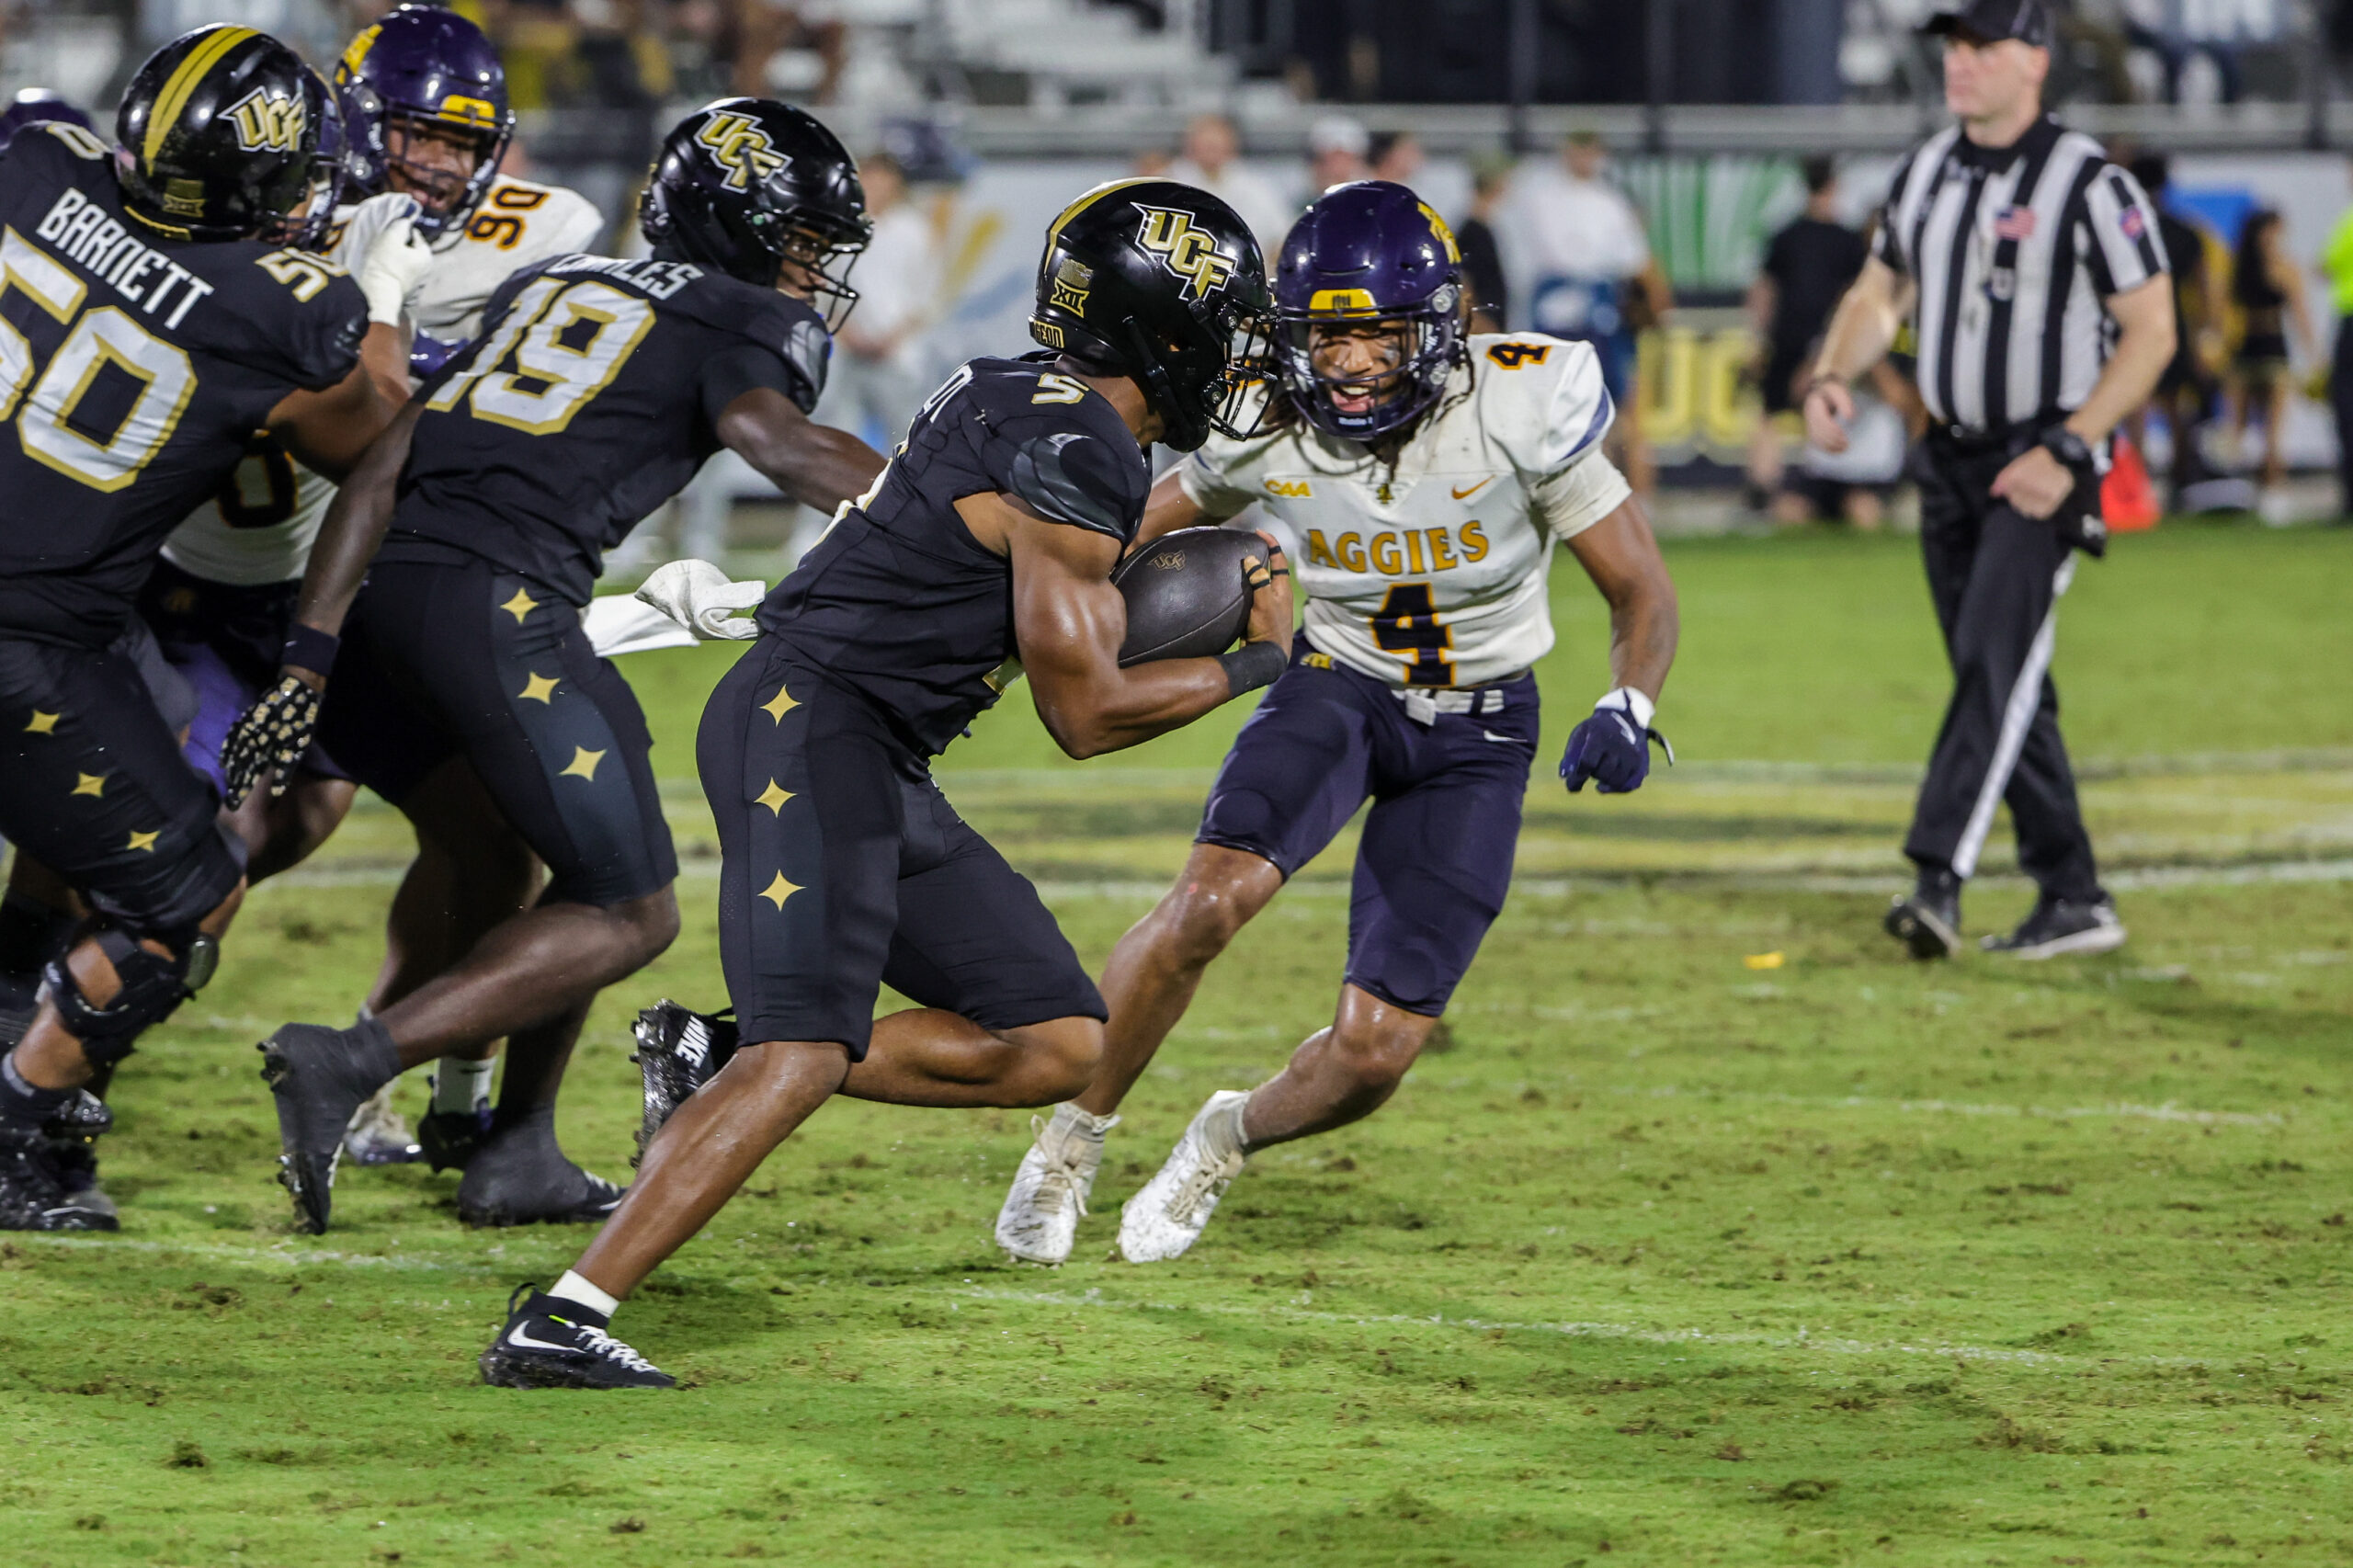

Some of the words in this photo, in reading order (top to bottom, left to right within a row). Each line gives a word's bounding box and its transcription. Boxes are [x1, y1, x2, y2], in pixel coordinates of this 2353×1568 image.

[221, 86, 306, 153] UCF
[695, 110, 792, 192] UCF
[464, 185, 550, 251] 90
[36, 187, 215, 331] BARNETT
[1131, 203, 1237, 301] UCF
[0, 223, 199, 494] 50
[426, 277, 657, 436] 19
[1030, 372, 1090, 404] 5
[1486, 341, 1552, 370] 4
[1265, 480, 1312, 497] CAA
[1150, 551, 1186, 571] UCF
[1307, 519, 1489, 575] AGGIES
[1370, 583, 1455, 688] 4
[674, 1015, 714, 1069] NIKE
